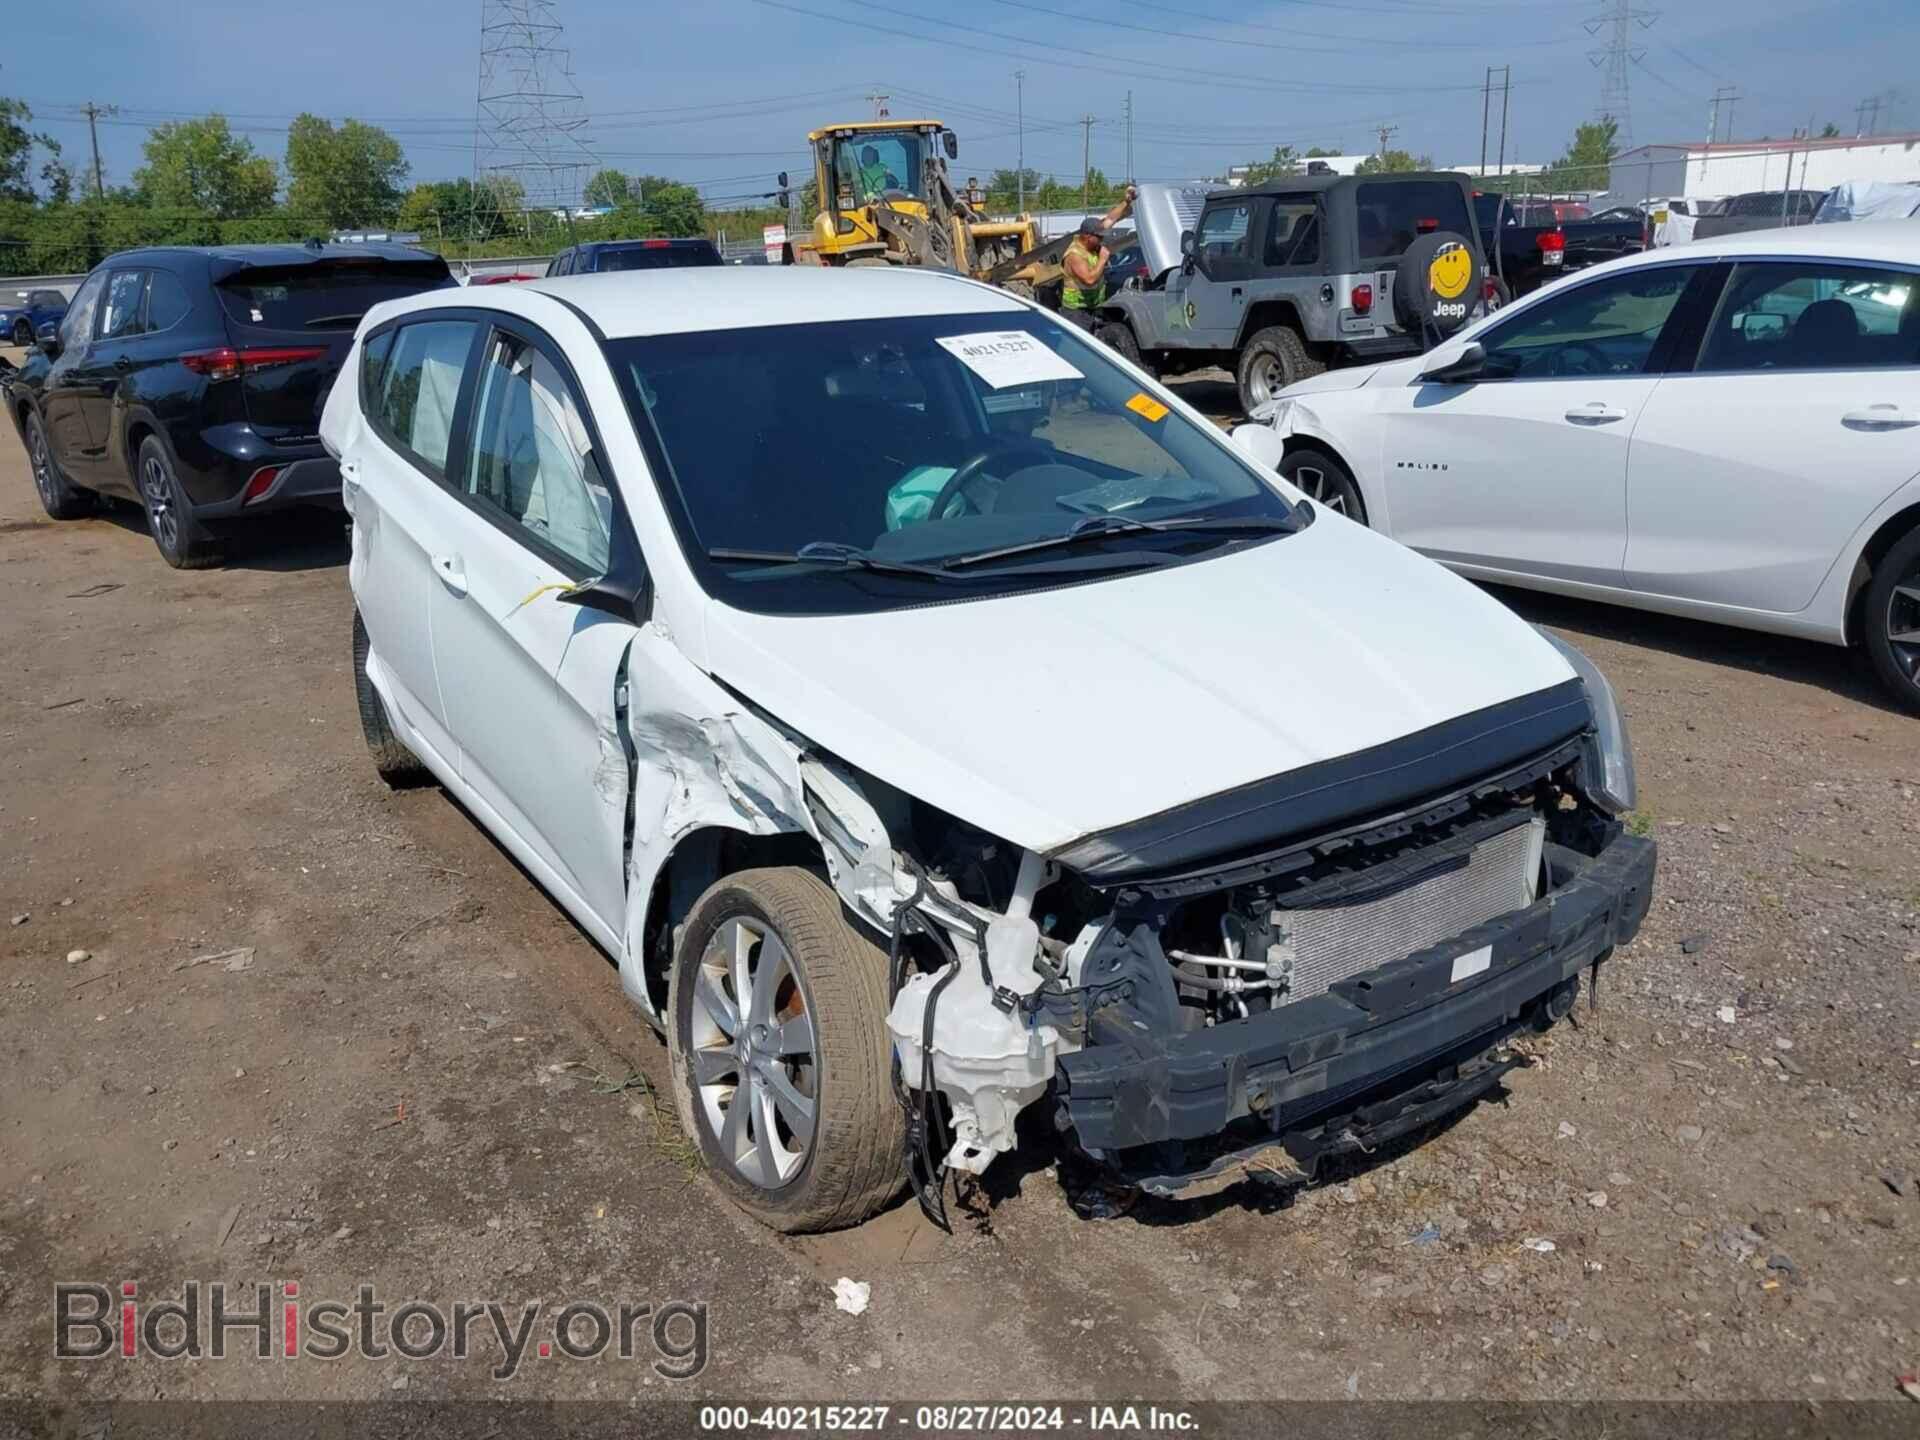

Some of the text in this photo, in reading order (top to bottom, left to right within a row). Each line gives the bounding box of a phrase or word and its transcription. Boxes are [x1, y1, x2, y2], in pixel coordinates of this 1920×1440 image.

[1433, 301, 1466, 318] Jeep
[962, 341, 1034, 357] 40215227
[1397, 461, 1448, 471] MALIBU
